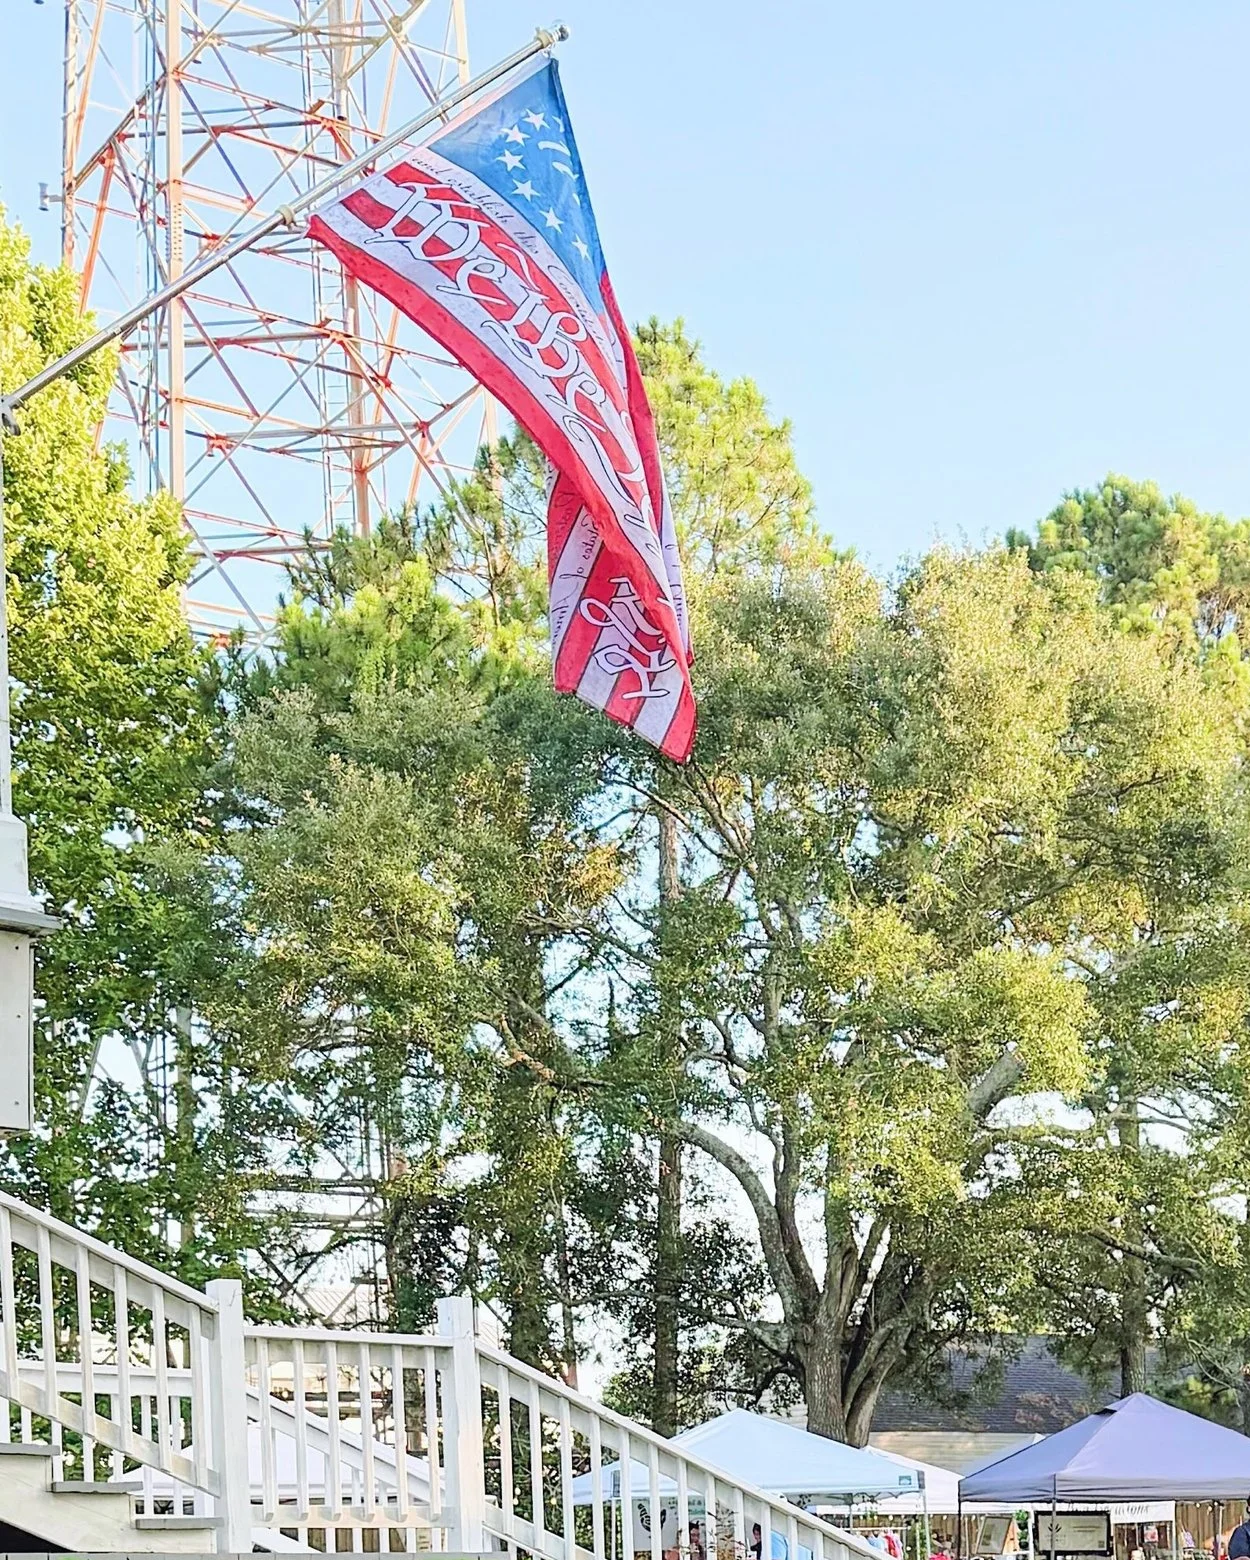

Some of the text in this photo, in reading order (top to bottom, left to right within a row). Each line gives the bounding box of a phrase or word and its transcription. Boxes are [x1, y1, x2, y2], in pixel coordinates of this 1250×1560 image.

[447, 178, 515, 224] establish
[513, 231, 538, 255] this
[363, 181, 509, 306] We
[480, 242, 607, 432] the
